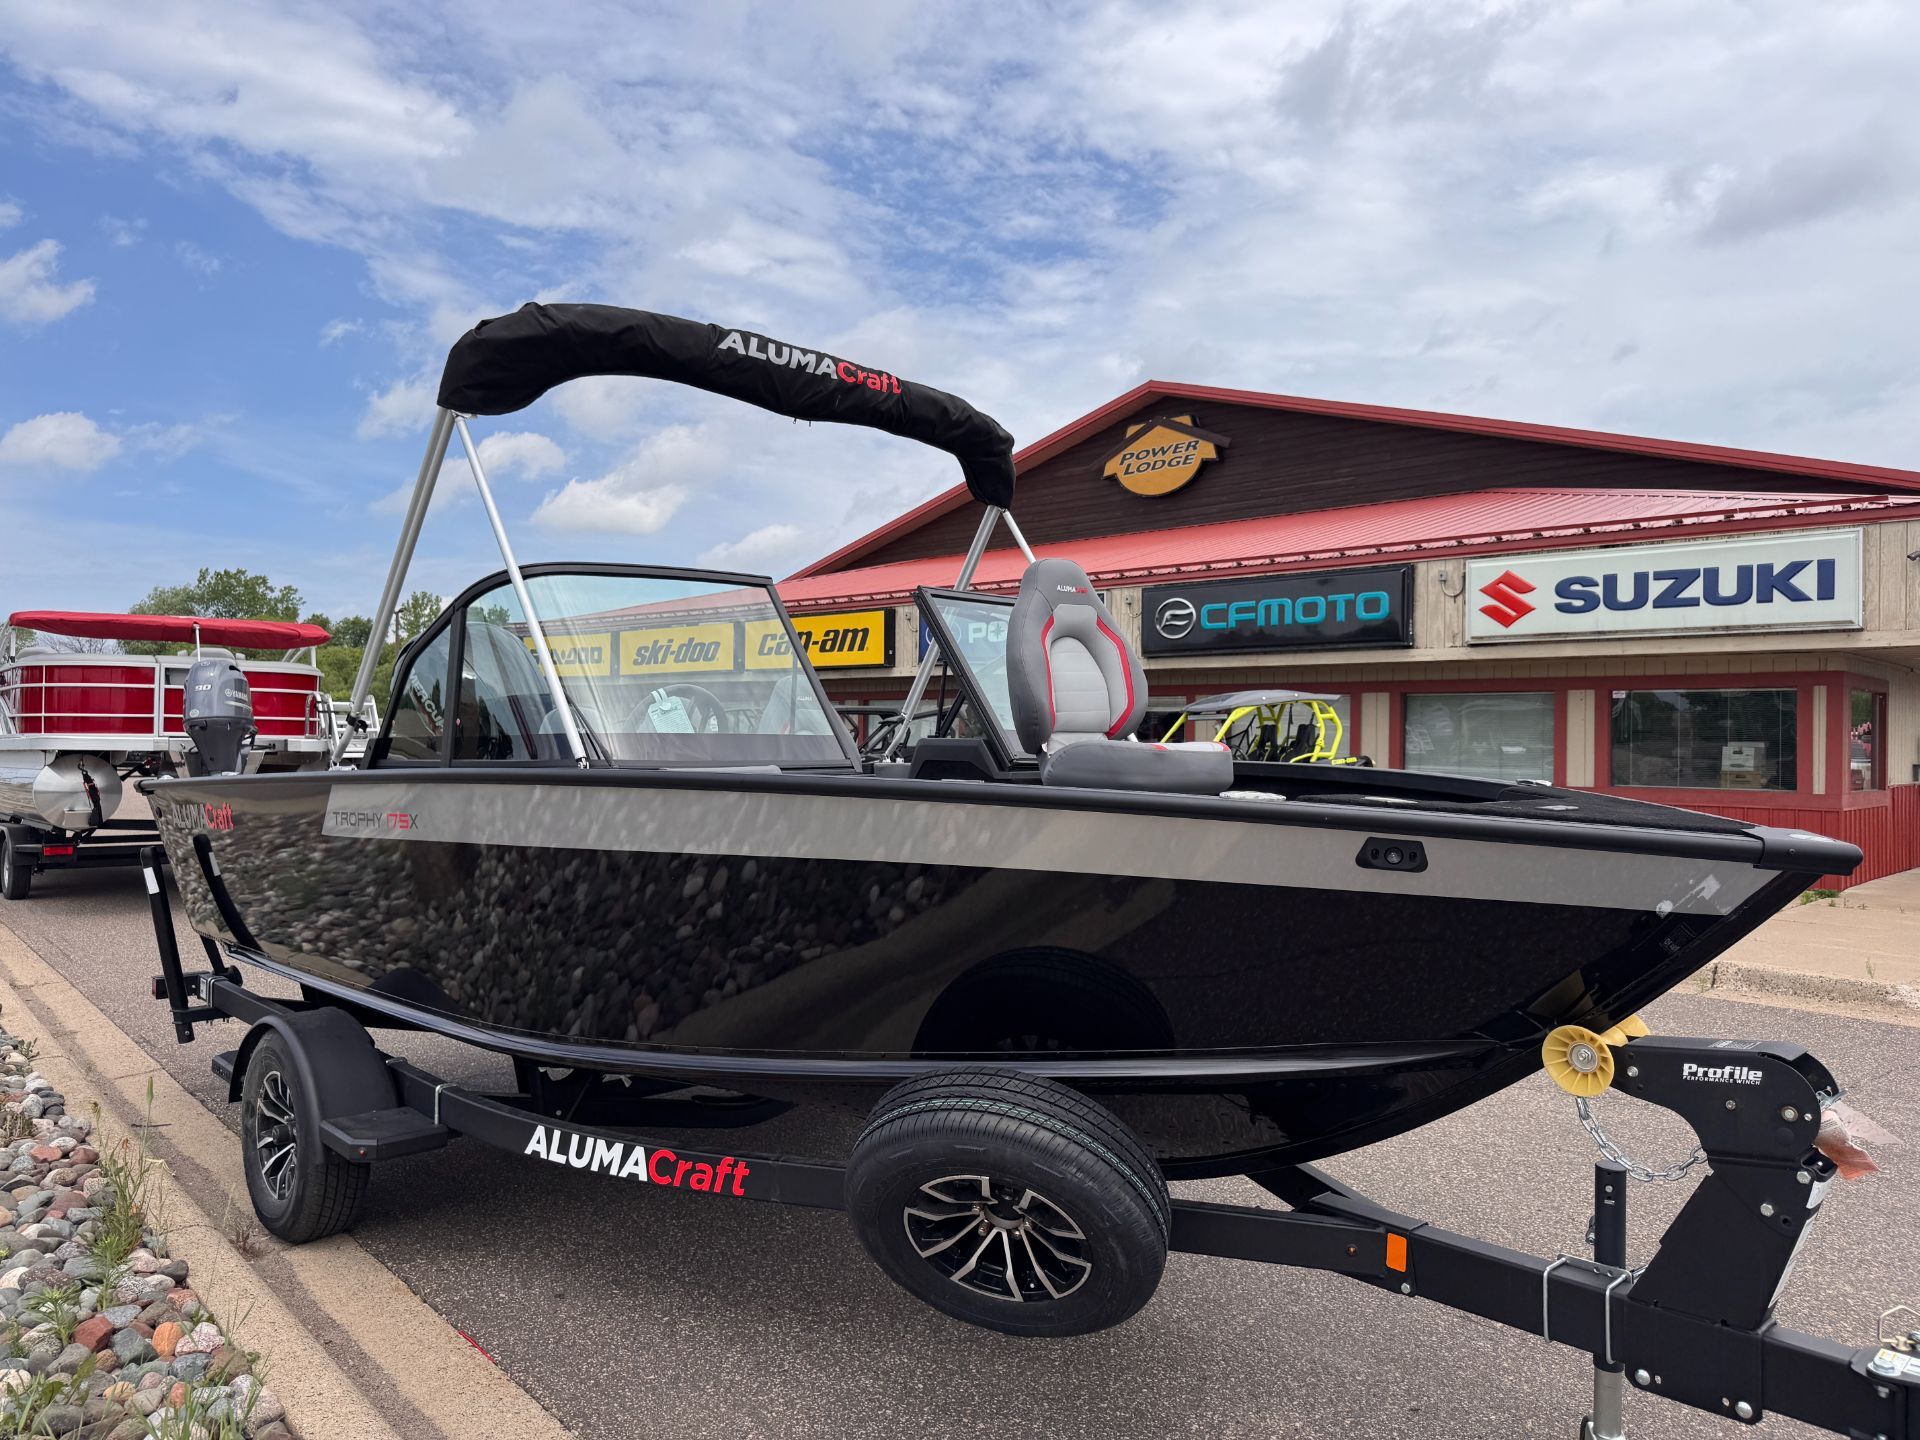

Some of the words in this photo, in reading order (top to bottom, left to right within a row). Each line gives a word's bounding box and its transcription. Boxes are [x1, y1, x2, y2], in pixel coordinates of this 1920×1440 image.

[717, 331, 902, 394] ALUMACraft
[1118, 439, 1200, 466] POWER
[1123, 453, 1196, 476] LODGE
[1554, 558, 1836, 614] SUZUKI
[1200, 591, 1390, 629] CFMOTO
[632, 637, 720, 665] ski-doo
[332, 811, 383, 828] TROPHY
[1682, 1063, 1763, 1081] Profile
[1682, 1075, 1734, 1084] PERFORMANCE
[524, 1124, 750, 1196] ALUMACraft
